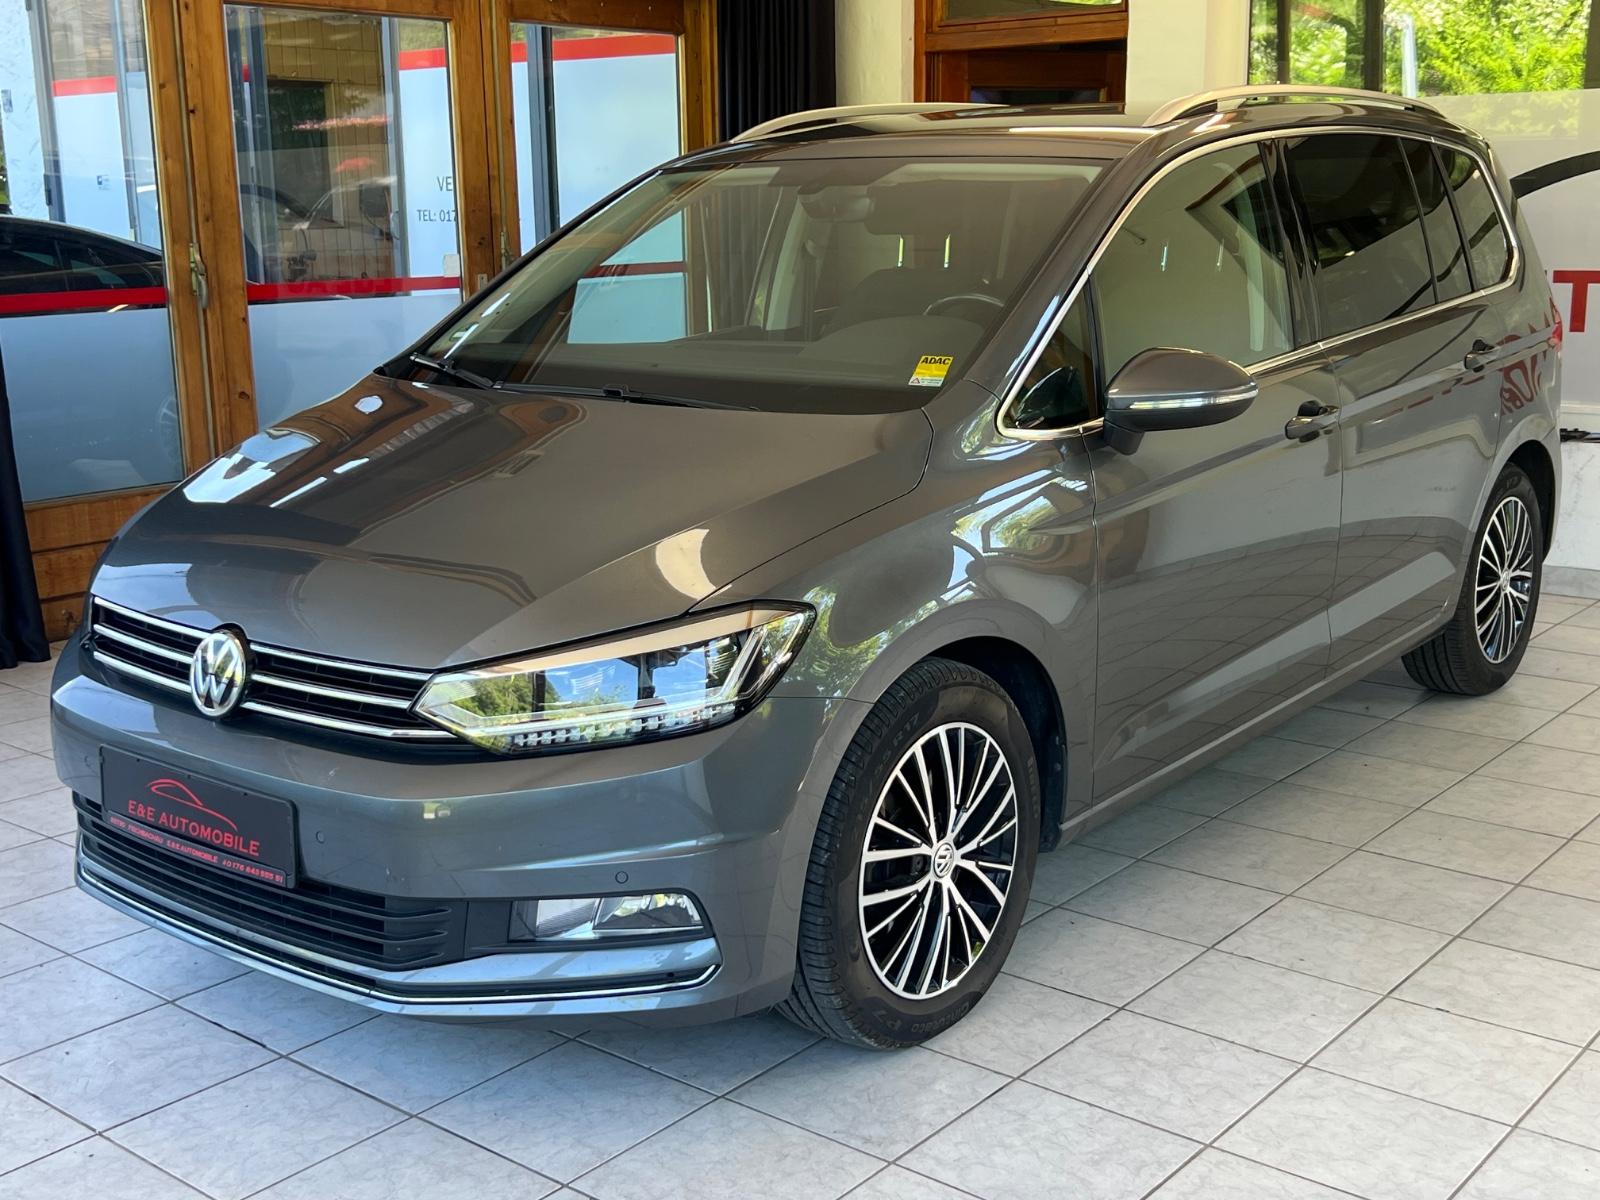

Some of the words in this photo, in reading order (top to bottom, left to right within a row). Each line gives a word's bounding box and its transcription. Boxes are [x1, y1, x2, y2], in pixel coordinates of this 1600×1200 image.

[920, 356, 951, 365] ADAC
[128, 800, 155, 822] E&E
[158, 812, 260, 857] AUTOMOBILE
